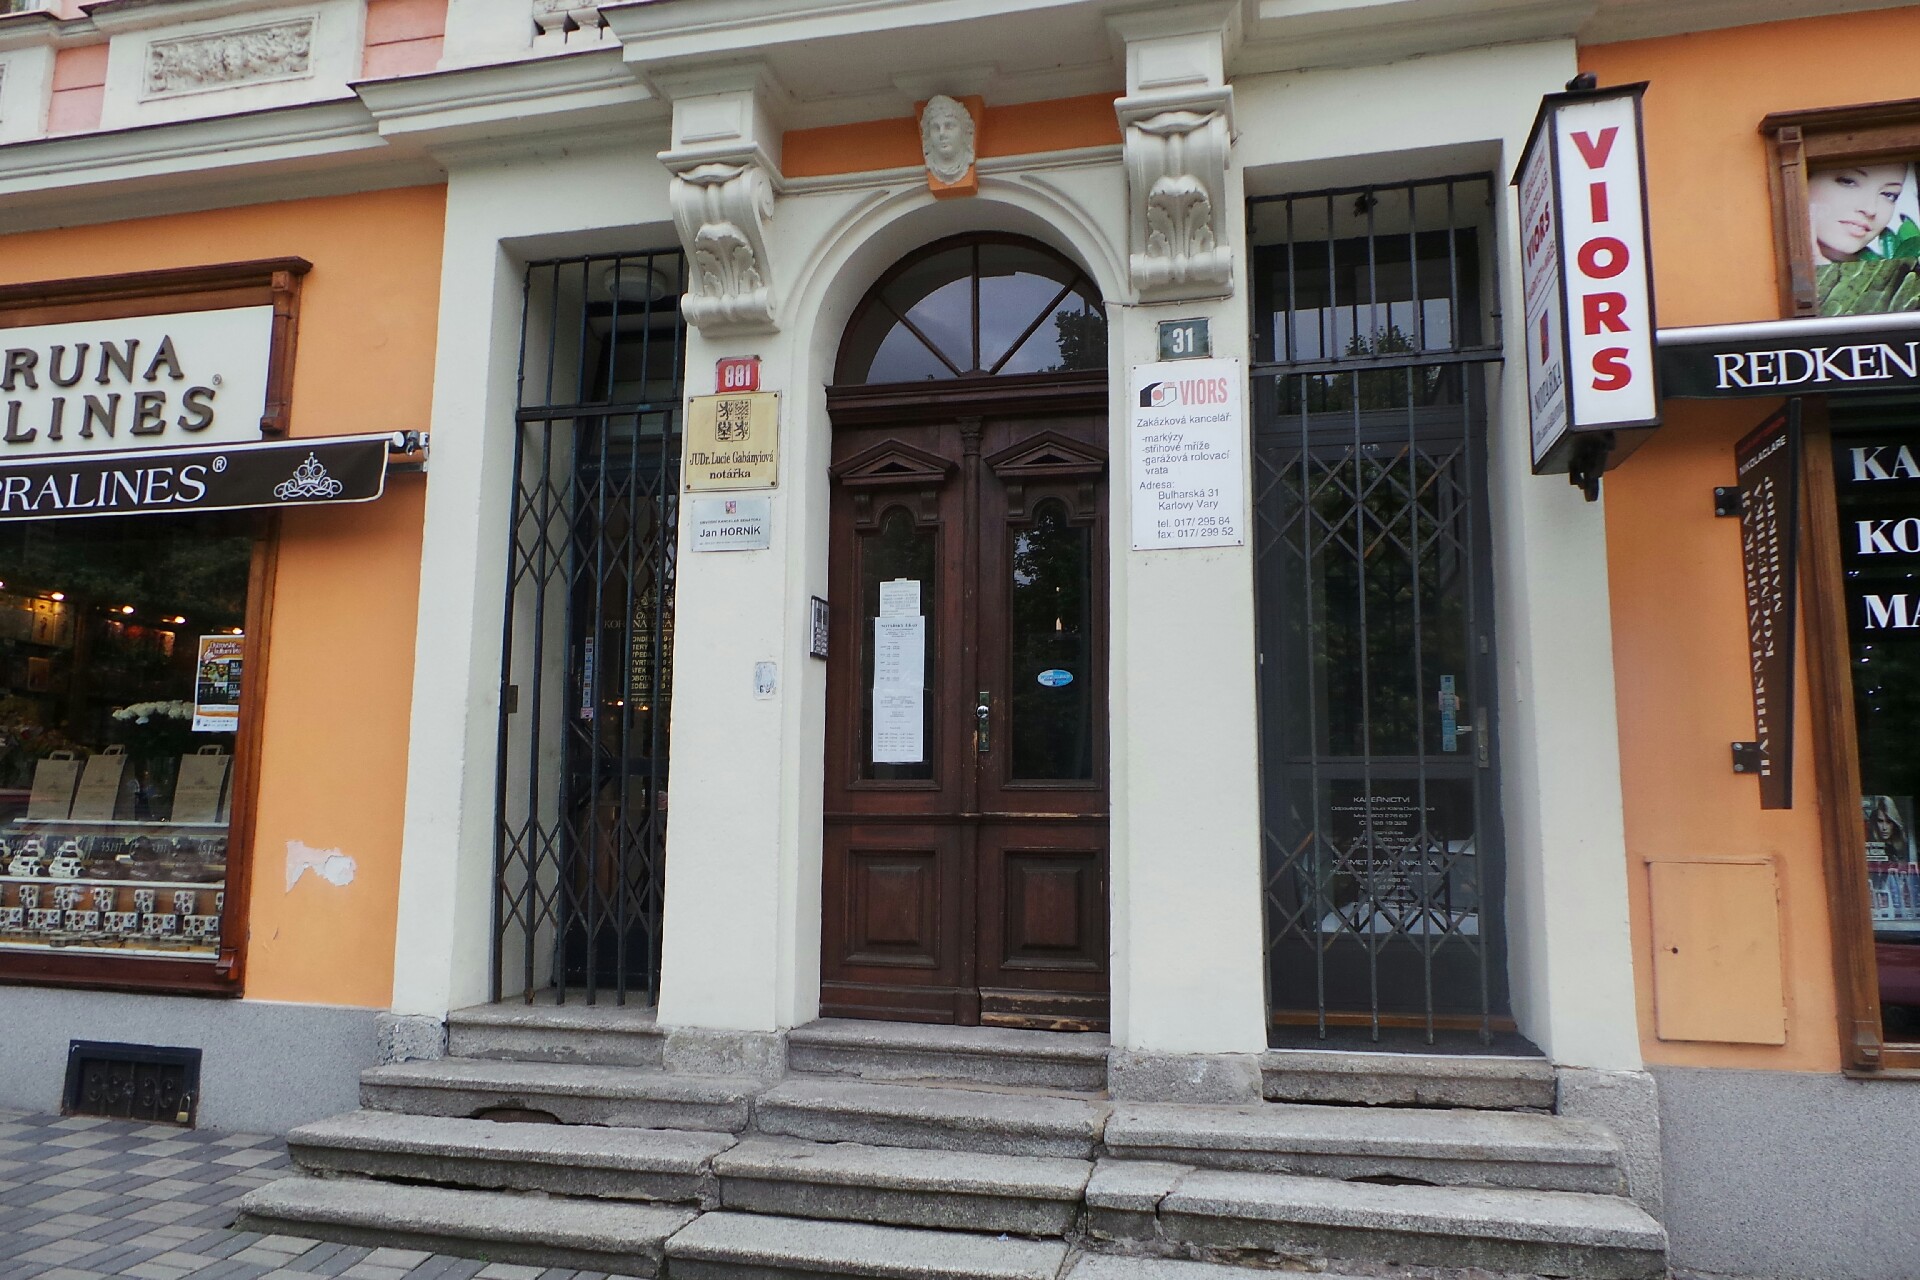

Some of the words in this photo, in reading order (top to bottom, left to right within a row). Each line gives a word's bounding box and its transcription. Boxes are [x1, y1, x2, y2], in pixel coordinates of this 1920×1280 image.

[1526, 201, 1551, 267] VIORS
[1570, 126, 1632, 391] VIORS
[1171, 327, 1194, 354] 31
[0, 334, 184, 391] RUNA
[1714, 341, 1920, 388] REDKEN
[724, 364, 751, 388] 881
[1180, 377, 1228, 405] VIORS
[1137, 416, 1186, 428] Zakázková
[1189, 412, 1232, 424] kancelář:
[1184, 440, 1210, 451] mříže
[689, 452, 711, 466] JUDr.
[711, 451, 731, 465] Lucie
[732, 450, 774, 467] Gabányiová
[1190, 450, 1230, 461] rolovací
[1849, 445, 1920, 481] KA
[709, 468, 751, 479] notářka
[1145, 466, 1169, 475] vrata
[1139, 481, 1175, 490] Adresa:
[1158, 489, 1205, 500] Bulharská
[1208, 488, 1219, 498] 31
[1158, 501, 1194, 511] Karlovy
[1196, 499, 1219, 510] Vary
[1157, 519, 1172, 528] tel.
[1174, 517, 1196, 528] 017/
[1197, 517, 1216, 526] 295
[1218, 516, 1231, 526] 84
[699, 529, 718, 538] Jan
[720, 524, 761, 537] HORNÍK
[1157, 530, 1175, 539] fax:
[1177, 529, 1199, 538] 017/
[1200, 528, 1219, 537] 299
[1221, 527, 1234, 536] 52
[1862, 594, 1920, 629] M
